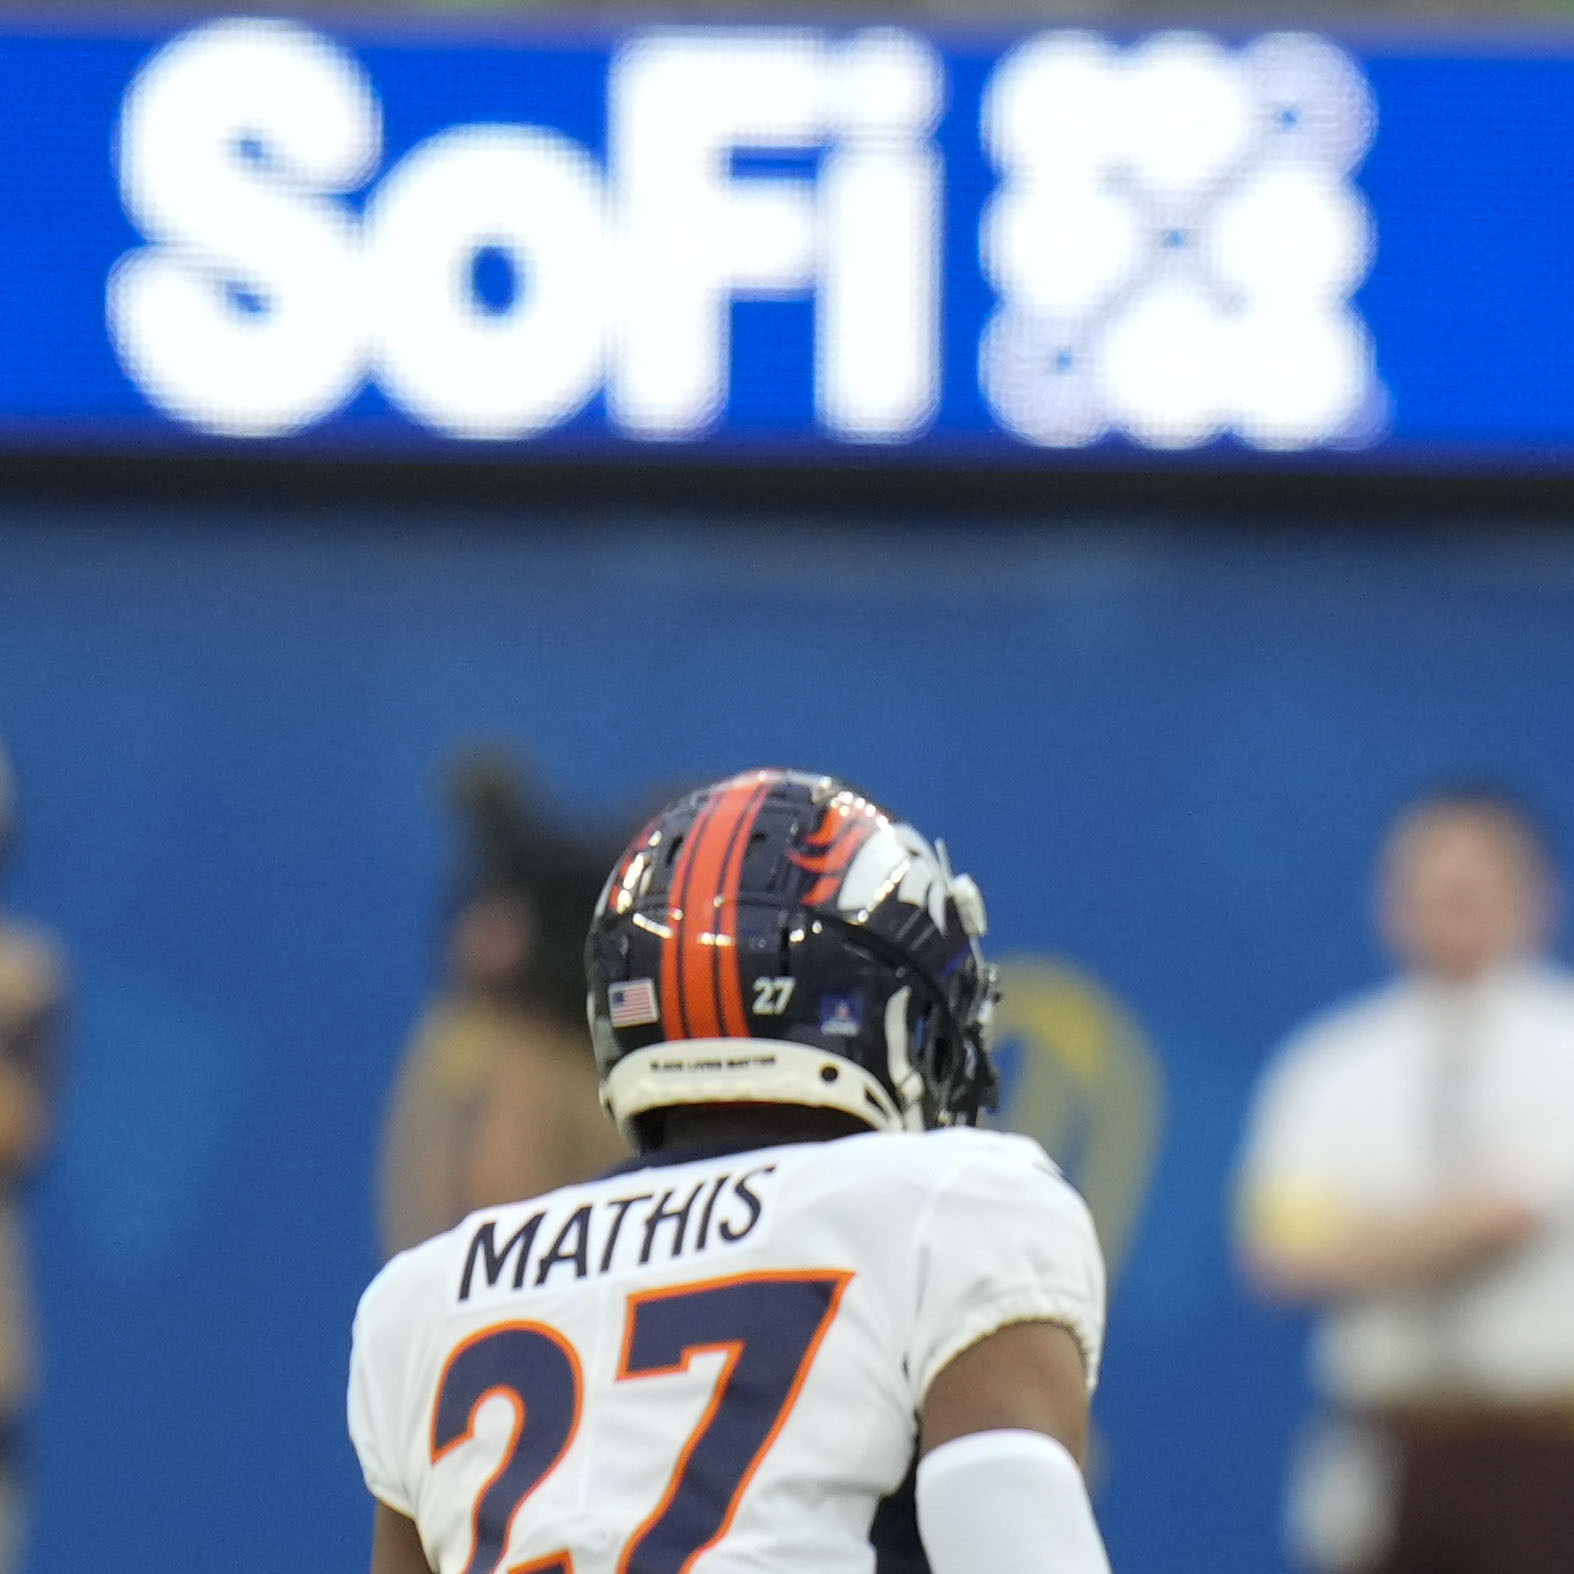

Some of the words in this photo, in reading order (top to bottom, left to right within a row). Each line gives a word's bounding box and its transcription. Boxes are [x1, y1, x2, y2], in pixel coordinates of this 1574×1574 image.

[106, 17, 944, 443] SoFi
[753, 977, 796, 1014] 27
[458, 1166, 776, 1301] MATHIS
